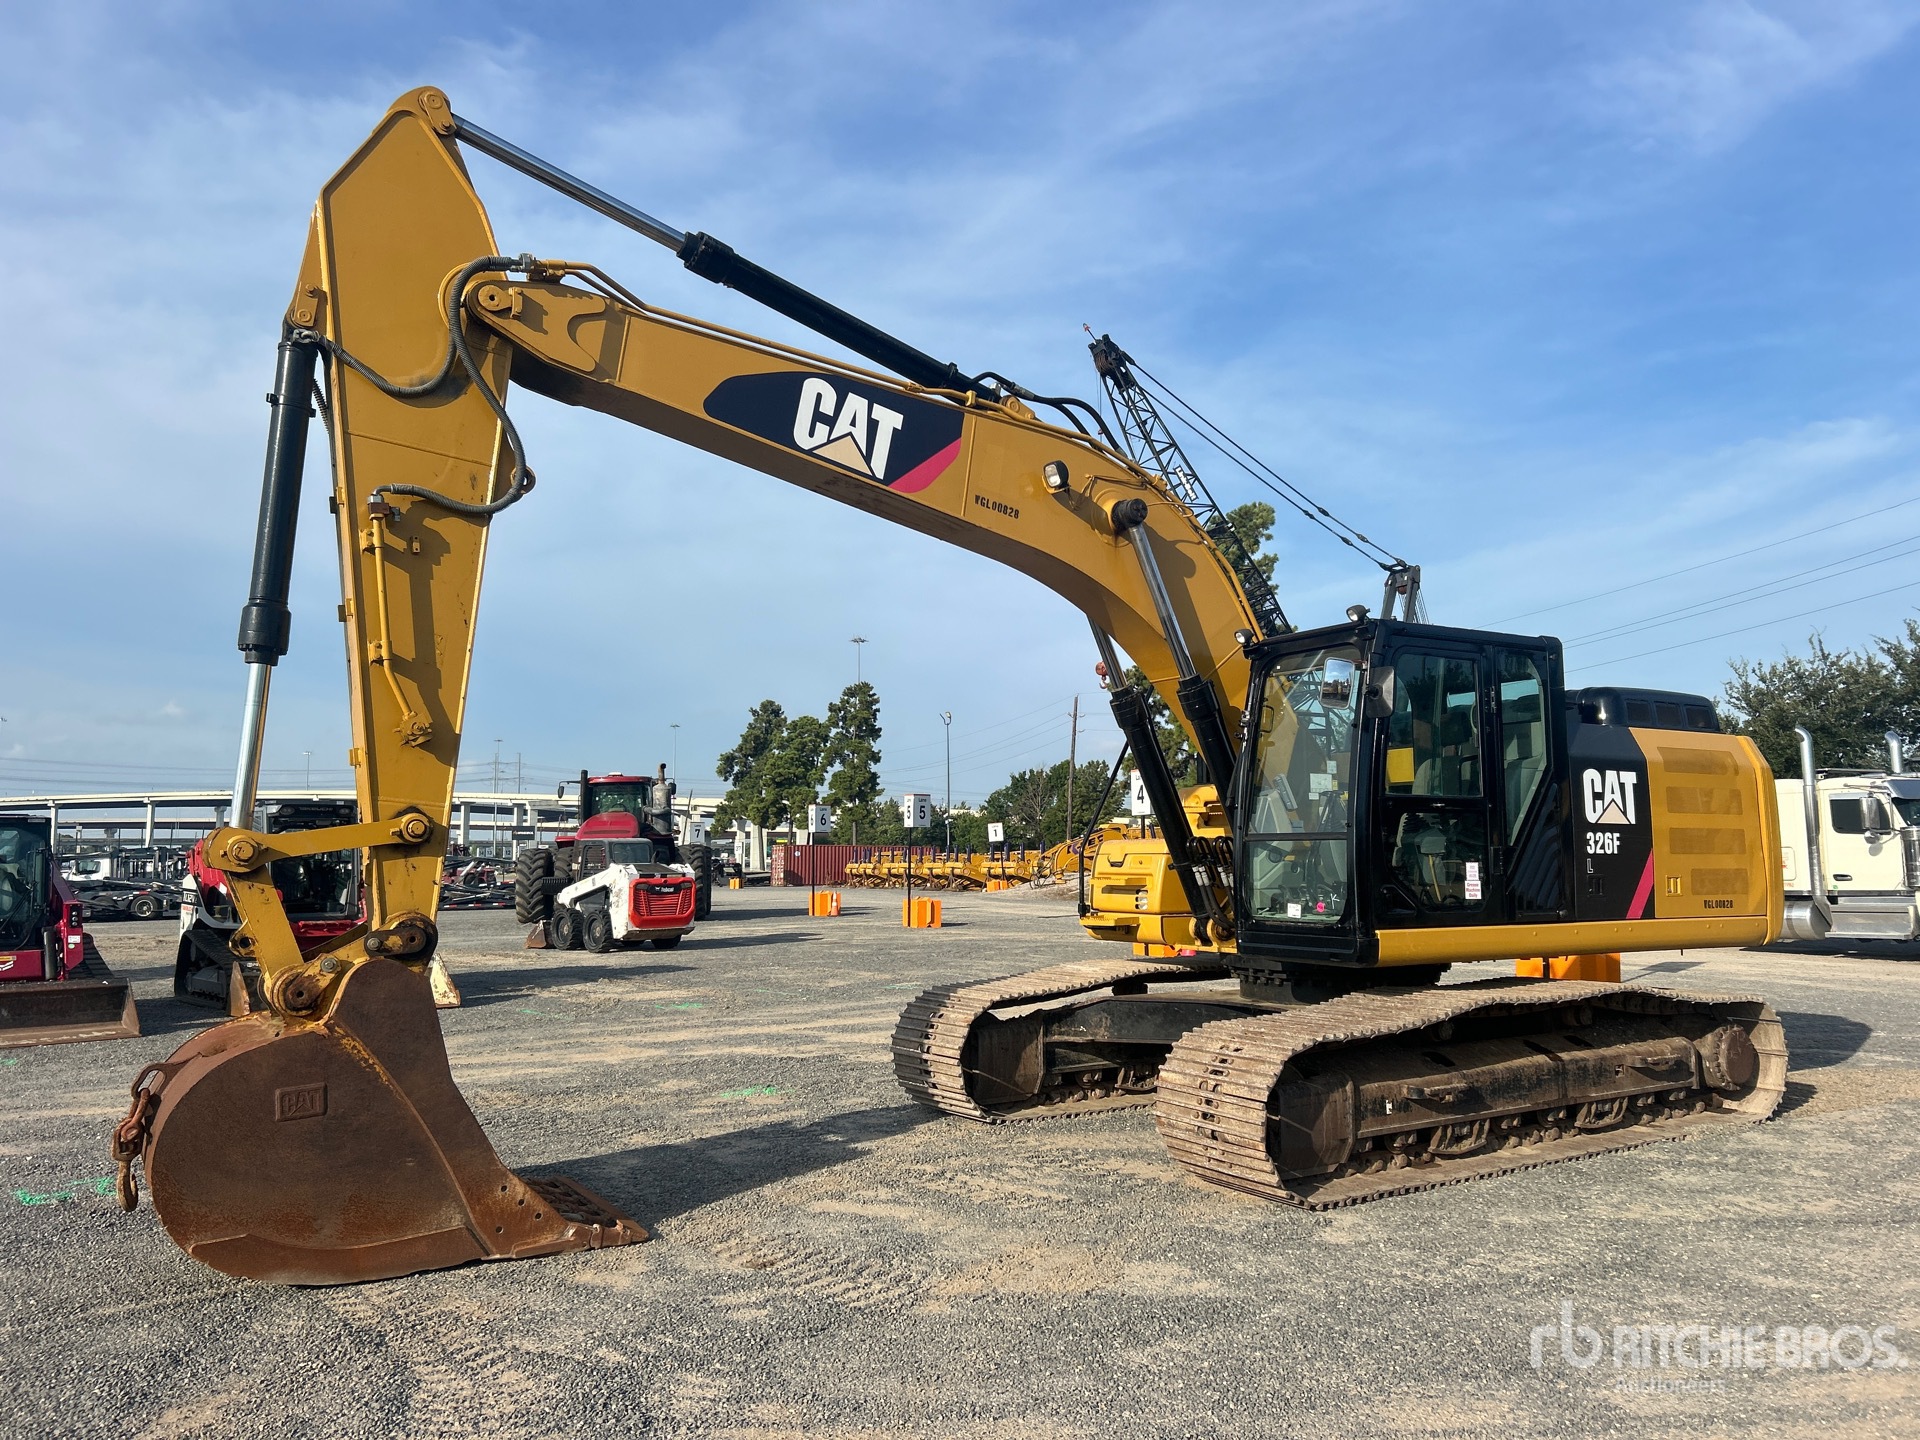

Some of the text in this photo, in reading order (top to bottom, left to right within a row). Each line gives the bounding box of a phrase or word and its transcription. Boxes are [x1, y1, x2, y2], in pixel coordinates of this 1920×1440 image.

[793, 377, 904, 480] CAT
[974, 494, 1020, 520] WGL00828
[1136, 784, 1145, 804] 4
[1582, 768, 1637, 825] CAT
[820, 813, 827, 826] 6
[919, 805, 926, 820] 5
[694, 829, 701, 838] 7
[993, 829, 998, 838] 1
[1586, 831, 1621, 855] 326F
[1586, 858, 1594, 874] L
